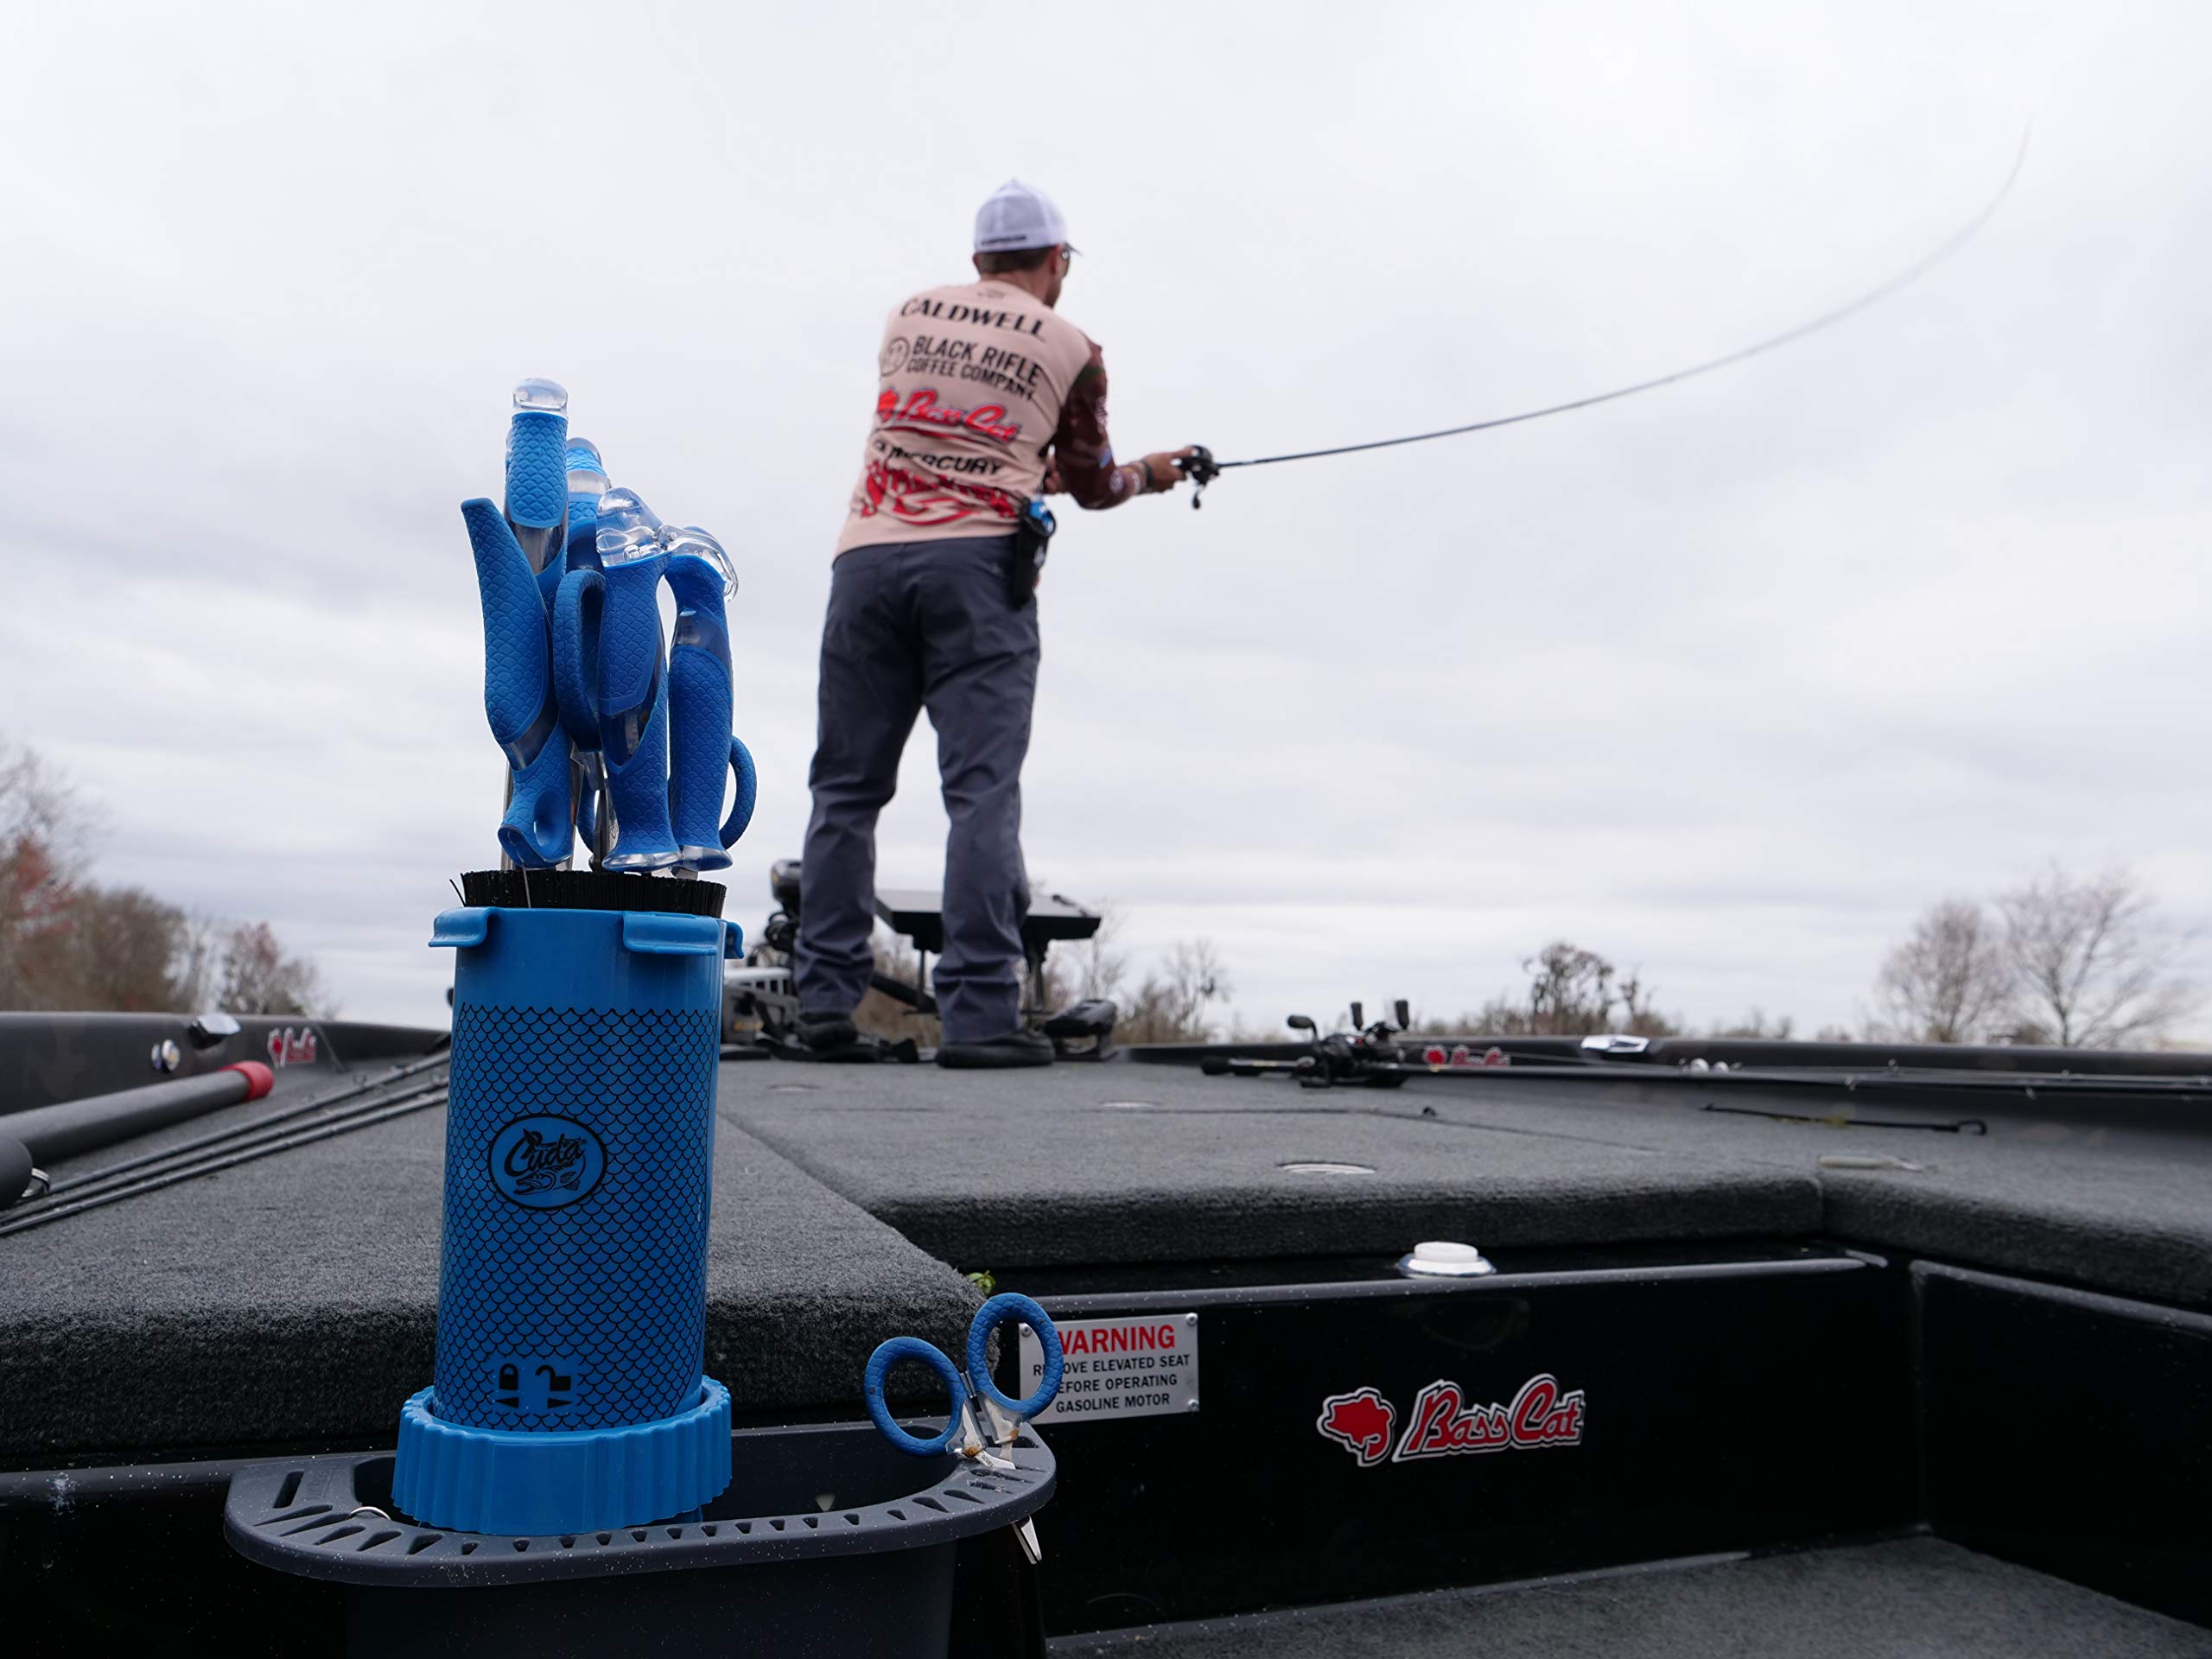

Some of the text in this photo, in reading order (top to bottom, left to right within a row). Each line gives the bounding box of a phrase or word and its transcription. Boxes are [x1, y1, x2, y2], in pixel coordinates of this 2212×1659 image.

[901, 298, 1046, 342] CALDWELL
[907, 359, 1036, 401] COFFEE COMPANY
[912, 335, 1042, 387] BLACK RIFLE
[1033, 1354, 1190, 1376] ROVE ELEVATED SEAT
[1058, 1374, 1178, 1394] EFORE OPERATING
[1056, 1393, 1170, 1413] GASOLINE MOTOR
[1395, 1374, 1585, 1460] Bass Cat
